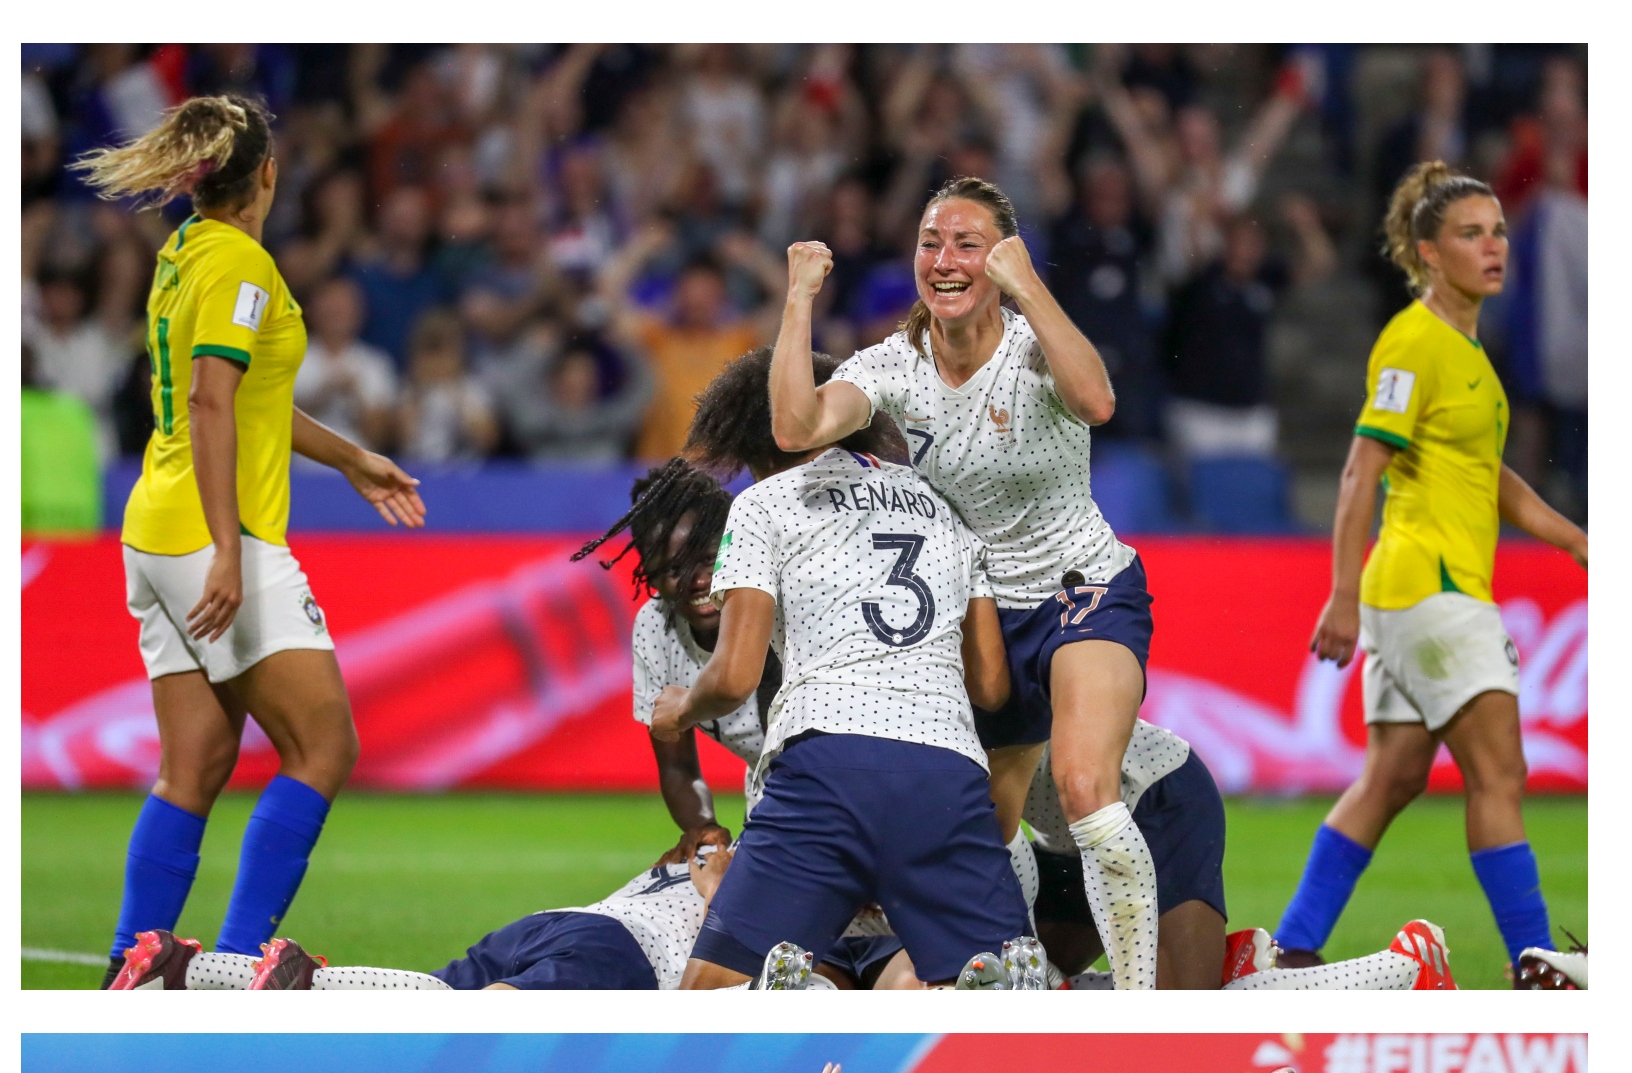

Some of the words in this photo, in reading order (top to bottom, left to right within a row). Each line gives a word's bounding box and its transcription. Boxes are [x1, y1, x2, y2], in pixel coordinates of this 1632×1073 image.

[828, 481, 938, 522] RENARD
[861, 532, 935, 649] 3
[1057, 585, 1108, 628] 17
